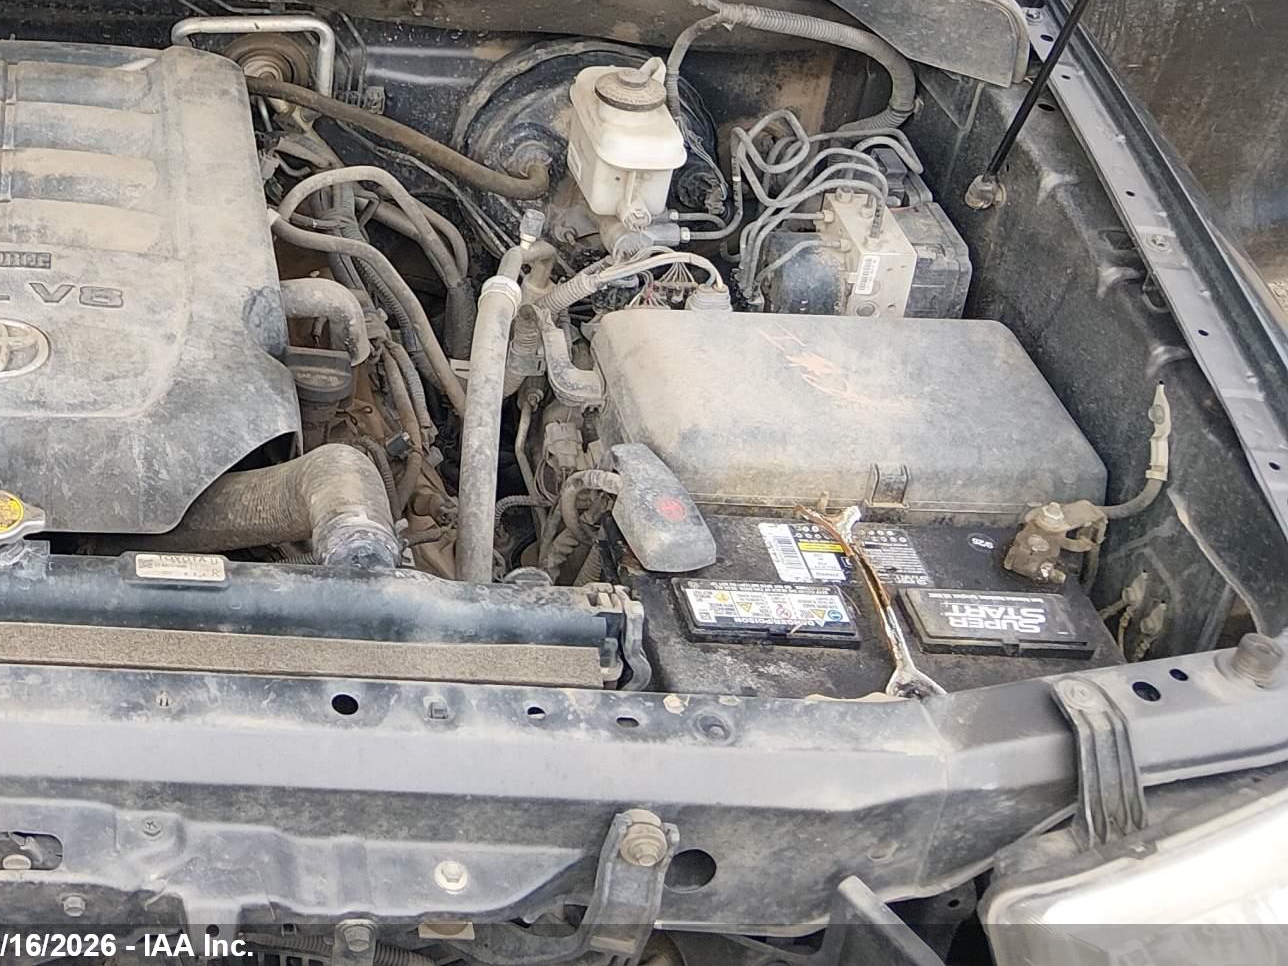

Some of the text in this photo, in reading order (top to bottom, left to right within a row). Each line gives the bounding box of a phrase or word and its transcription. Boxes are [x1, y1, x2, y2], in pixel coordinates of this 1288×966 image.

[29, 282, 124, 308] V8
[944, 603, 1047, 625] START
[949, 616, 1041, 633] SUPER
